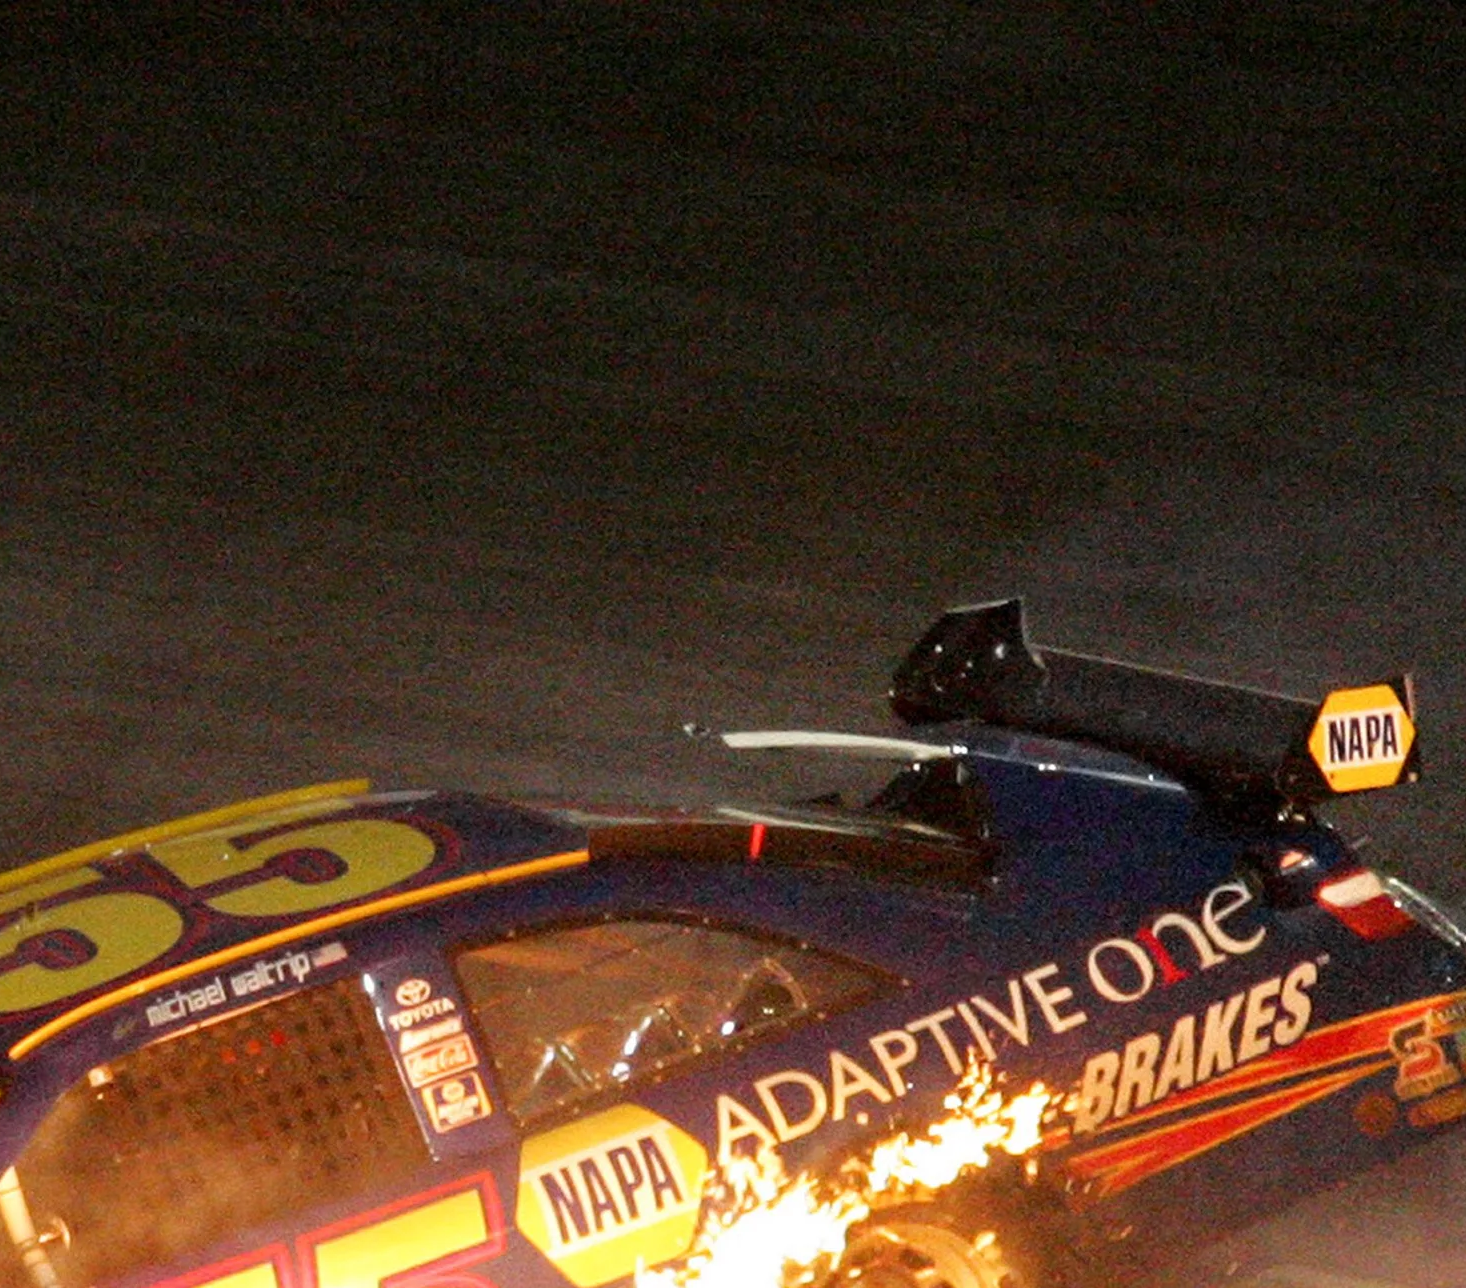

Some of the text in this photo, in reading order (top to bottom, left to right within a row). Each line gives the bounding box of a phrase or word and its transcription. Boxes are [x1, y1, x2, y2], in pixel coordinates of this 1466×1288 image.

[1328, 712, 1399, 763] NAPA
[146, 950, 311, 1028] michael waltrip
[388, 997, 455, 1031] TOYOTA
[716, 963, 1087, 1166] ADAPTIVE
[1072, 962, 1318, 1135] BRAKES
[539, 1159, 683, 1246] NAPA
